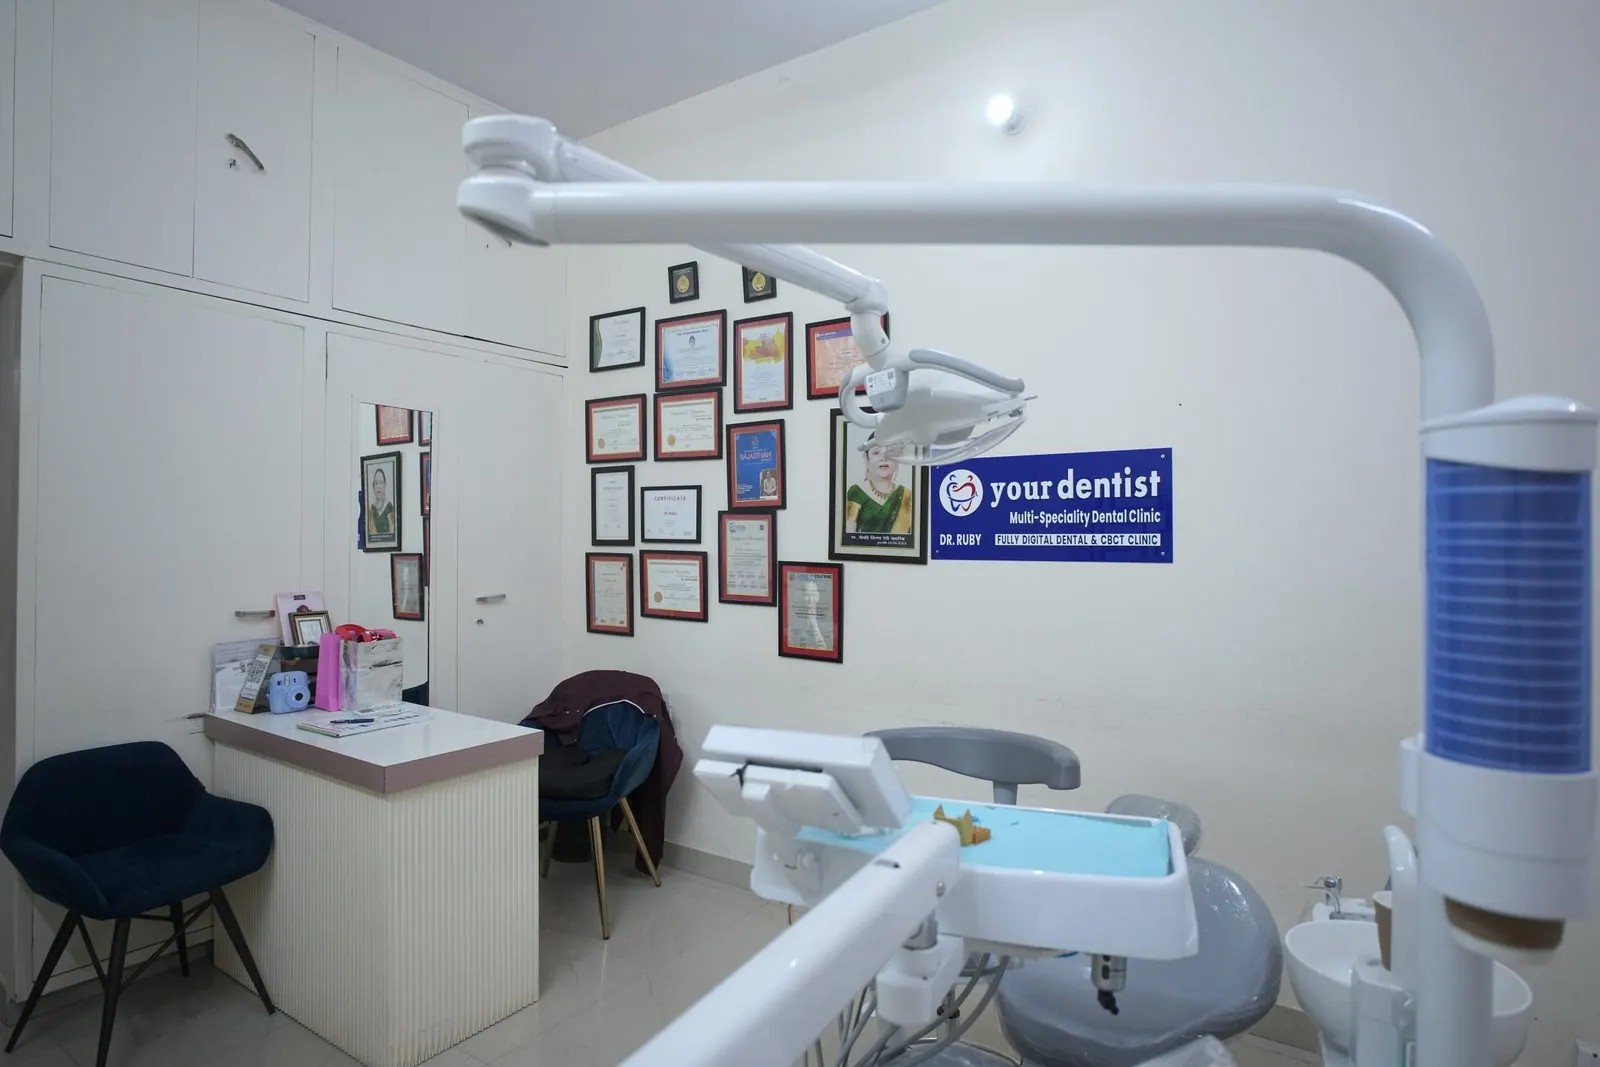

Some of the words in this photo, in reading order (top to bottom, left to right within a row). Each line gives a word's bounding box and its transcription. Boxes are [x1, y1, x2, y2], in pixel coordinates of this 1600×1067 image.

[990, 480, 1052, 508] your
[1057, 467, 1160, 499] dentist
[1010, 510, 1089, 527] Multi-Speciality
[1092, 509, 1127, 524] Dental
[1129, 508, 1161, 523] Clinic
[939, 534, 955, 546] DR.
[956, 534, 982, 546] RUBY
[997, 535, 1020, 545] FULLY
[1022, 535, 1053, 545] DIGITAL
[1056, 535, 1087, 545] DENTAL
[1091, 535, 1098, 545] &
[1101, 535, 1125, 545] CBCT
[1127, 535, 1159, 545] CLINIC
